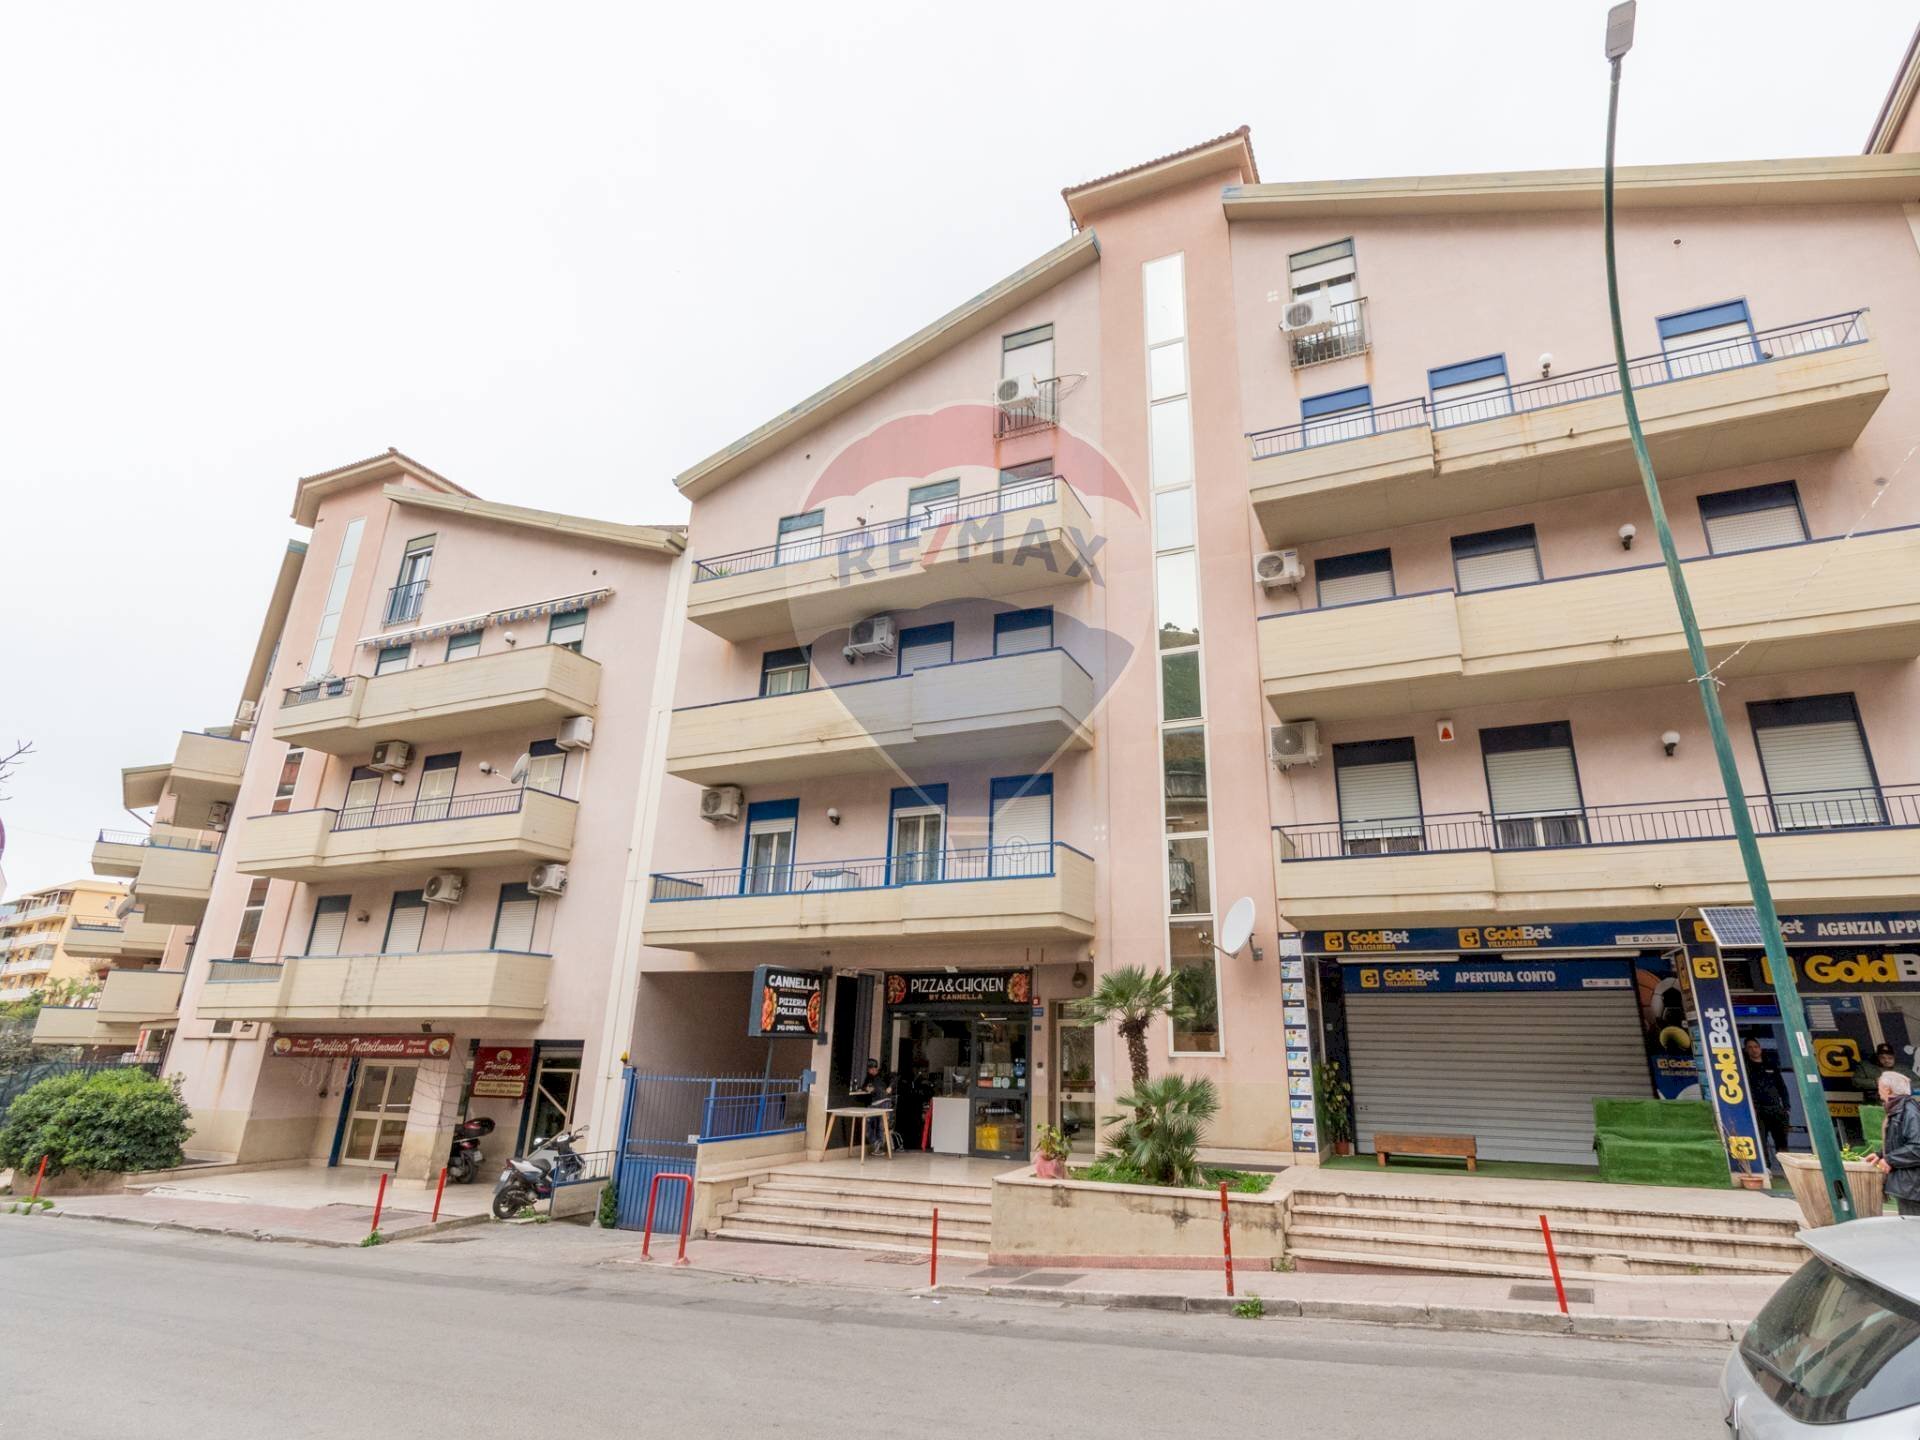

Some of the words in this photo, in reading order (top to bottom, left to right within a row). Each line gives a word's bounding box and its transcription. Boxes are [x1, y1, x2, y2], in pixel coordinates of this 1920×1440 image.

[1484, 925, 1553, 941] GoldBet
[1817, 920, 1887, 936] AGENZIA
[1888, 920, 1920, 934] IPP
[1347, 930, 1410, 944] GoldBet
[1383, 968, 1440, 981] GoldBet
[1455, 971, 1515, 983] APERTURA
[1516, 970, 1557, 982] CONTO
[768, 975, 820, 990] CANNELLA
[910, 977, 1004, 993] PIZZA&CHICKEN
[778, 997, 807, 1007] PIZZERIA
[928, 993, 939, 1001] BY
[941, 993, 984, 1001] CANNELLA
[776, 1006, 808, 1016] POLLERIA
[311, 1037, 348, 1055] Panificio
[350, 1037, 405, 1053] Tuttoilmondo
[1704, 1007, 1744, 1105] GoldBet
